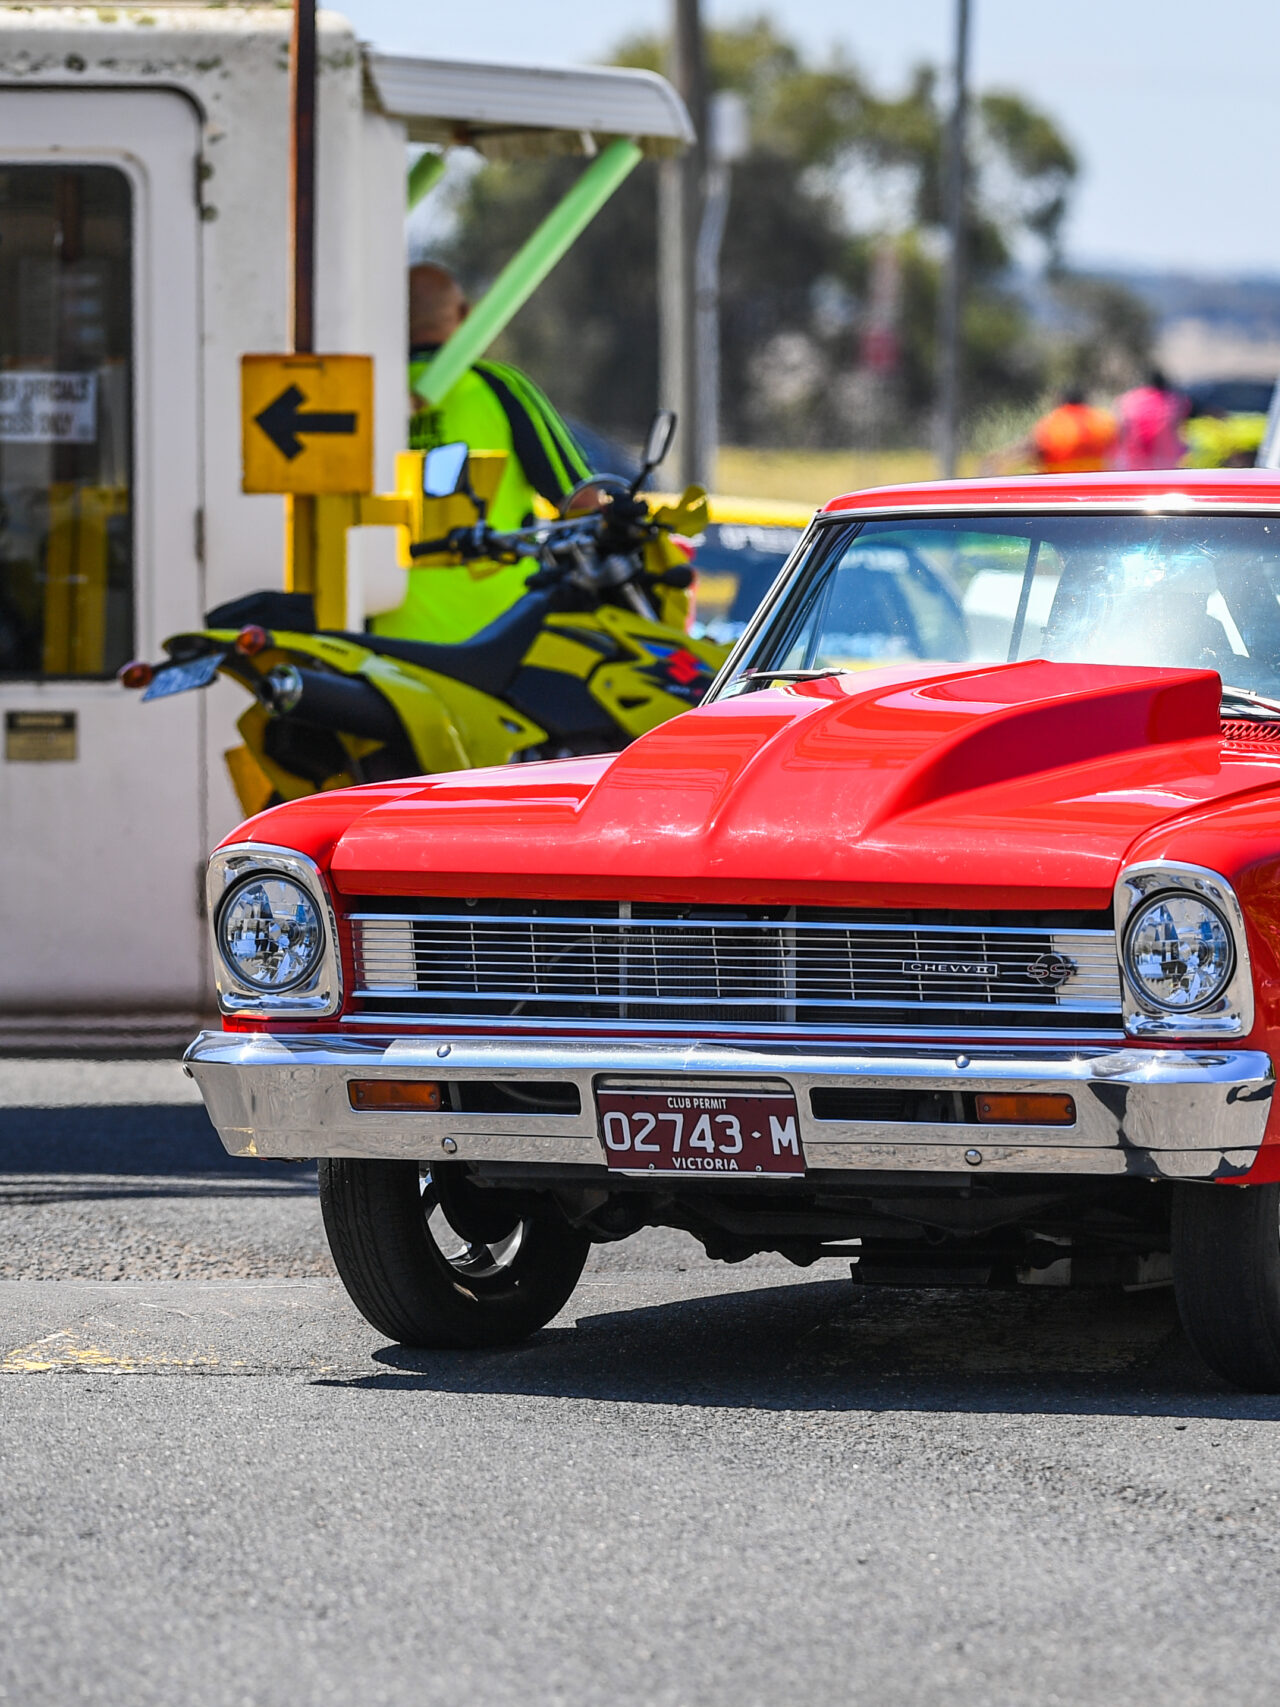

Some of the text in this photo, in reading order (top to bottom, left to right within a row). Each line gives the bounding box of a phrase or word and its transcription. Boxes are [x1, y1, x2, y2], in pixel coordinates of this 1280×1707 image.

[910, 963, 971, 974] CHEVY
[1026, 963, 1074, 979] SS
[667, 1097, 727, 1110] CLUB PERMIT
[671, 1156, 739, 1171] VICTORIA
